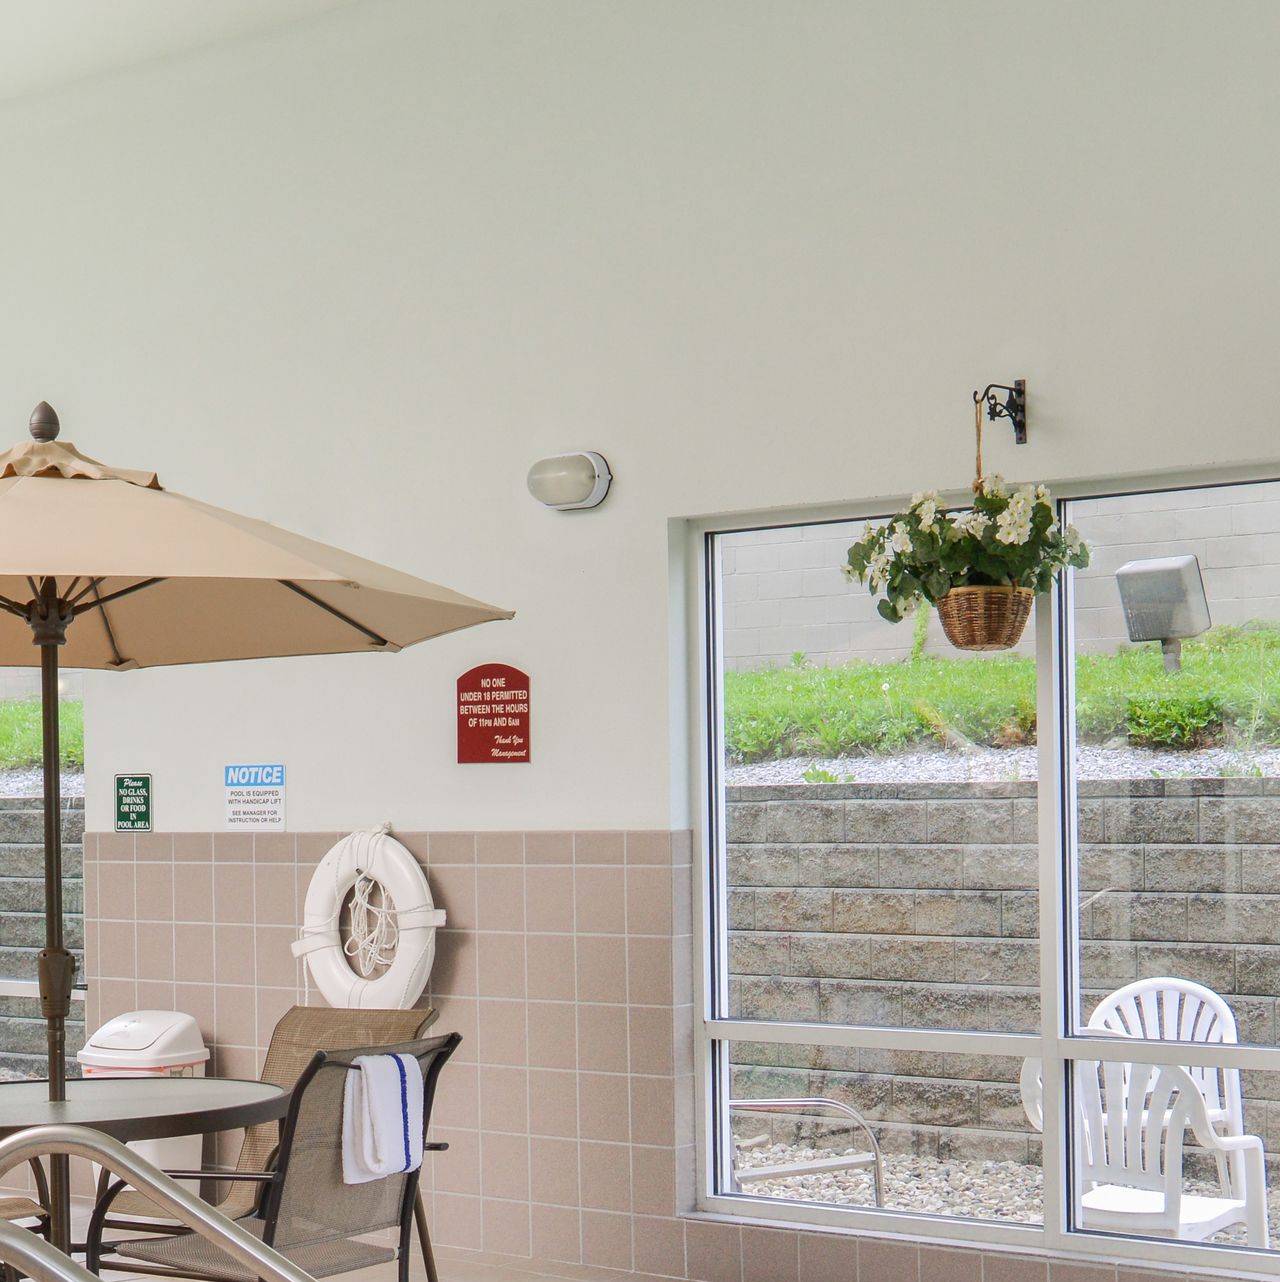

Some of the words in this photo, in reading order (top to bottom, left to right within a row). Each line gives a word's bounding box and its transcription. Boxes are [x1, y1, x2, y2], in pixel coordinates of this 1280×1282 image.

[481, 679, 491, 687] NO
[492, 678, 505, 687] ONE
[460, 692, 482, 701] UNDER
[483, 692, 490, 701] 18
[492, 691, 527, 700] PERMITTED
[460, 705, 490, 714] BETWEEN
[492, 705, 504, 713] THE
[506, 704, 528, 712] HOURS
[468, 718, 477, 727] OF
[493, 718, 506, 726] AND
[495, 735, 511, 744] Thank
[512, 735, 523, 745] You
[491, 749, 526, 758] Management
[228, 767, 282, 784] NOTICE
[123, 779, 142, 787] Please
